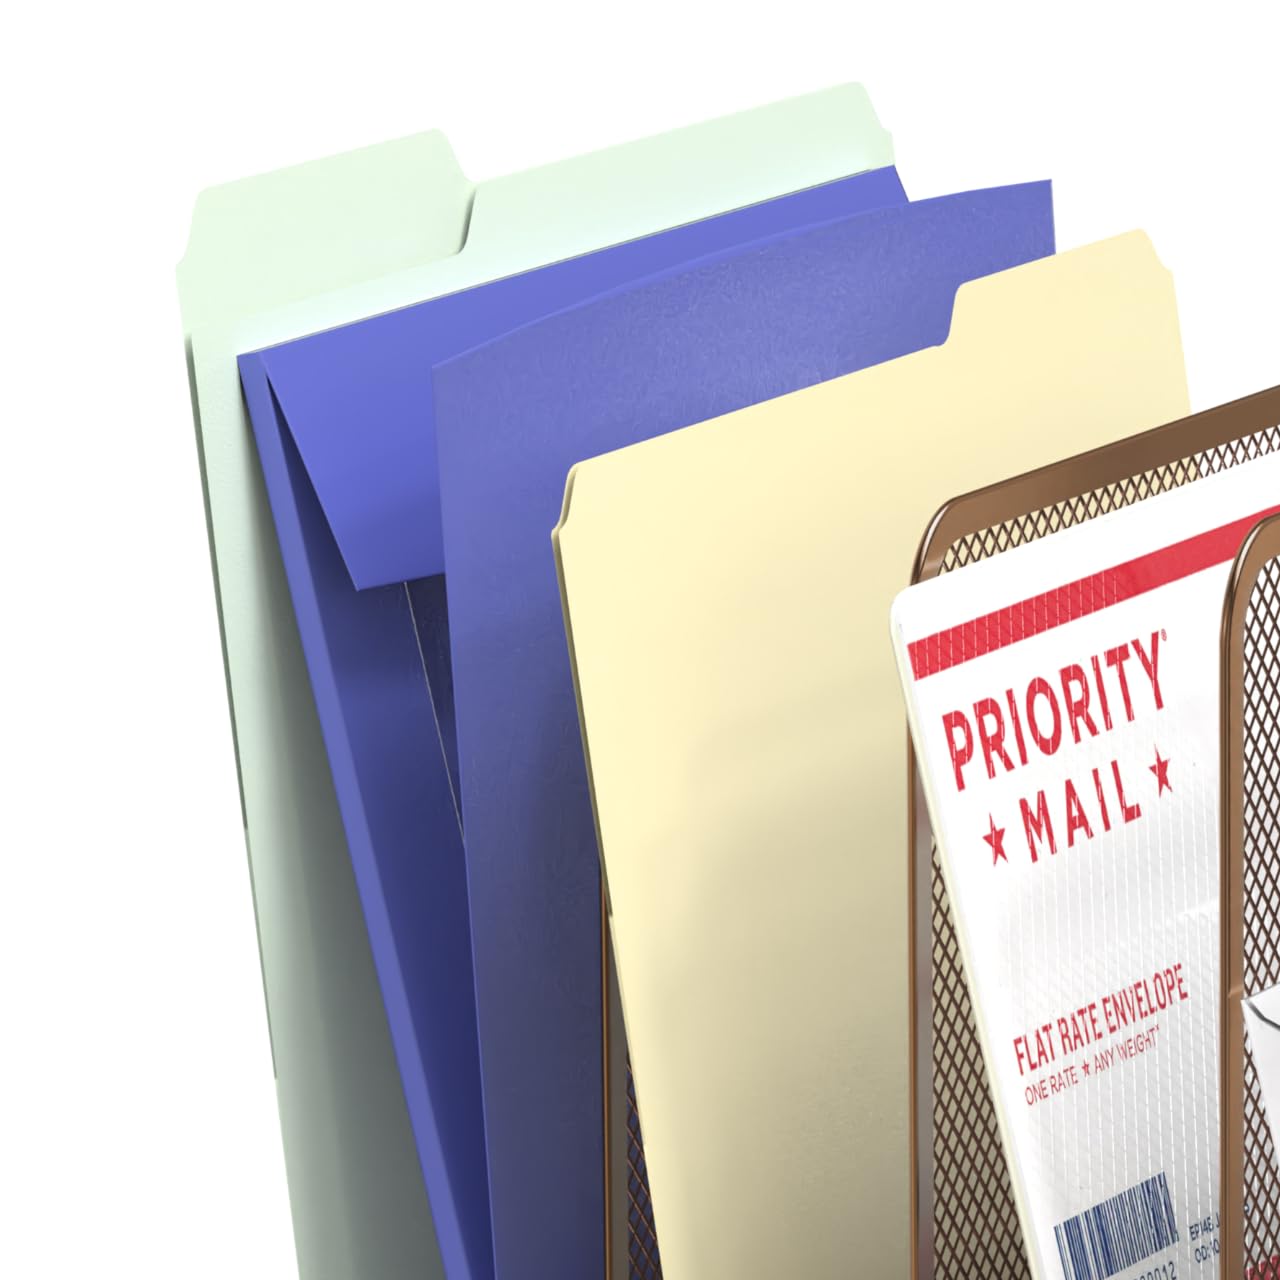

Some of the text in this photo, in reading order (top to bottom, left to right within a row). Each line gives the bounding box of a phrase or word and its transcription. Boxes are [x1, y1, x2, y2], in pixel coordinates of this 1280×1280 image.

[1018, 759, 1142, 864] MAIL
[1013, 962, 1189, 1076] FLAT RATE ENVELOPE
[1024, 1079, 1049, 1106] ONE
[1049, 1065, 1079, 1096] RATE
[1093, 1047, 1115, 1075] ANY
